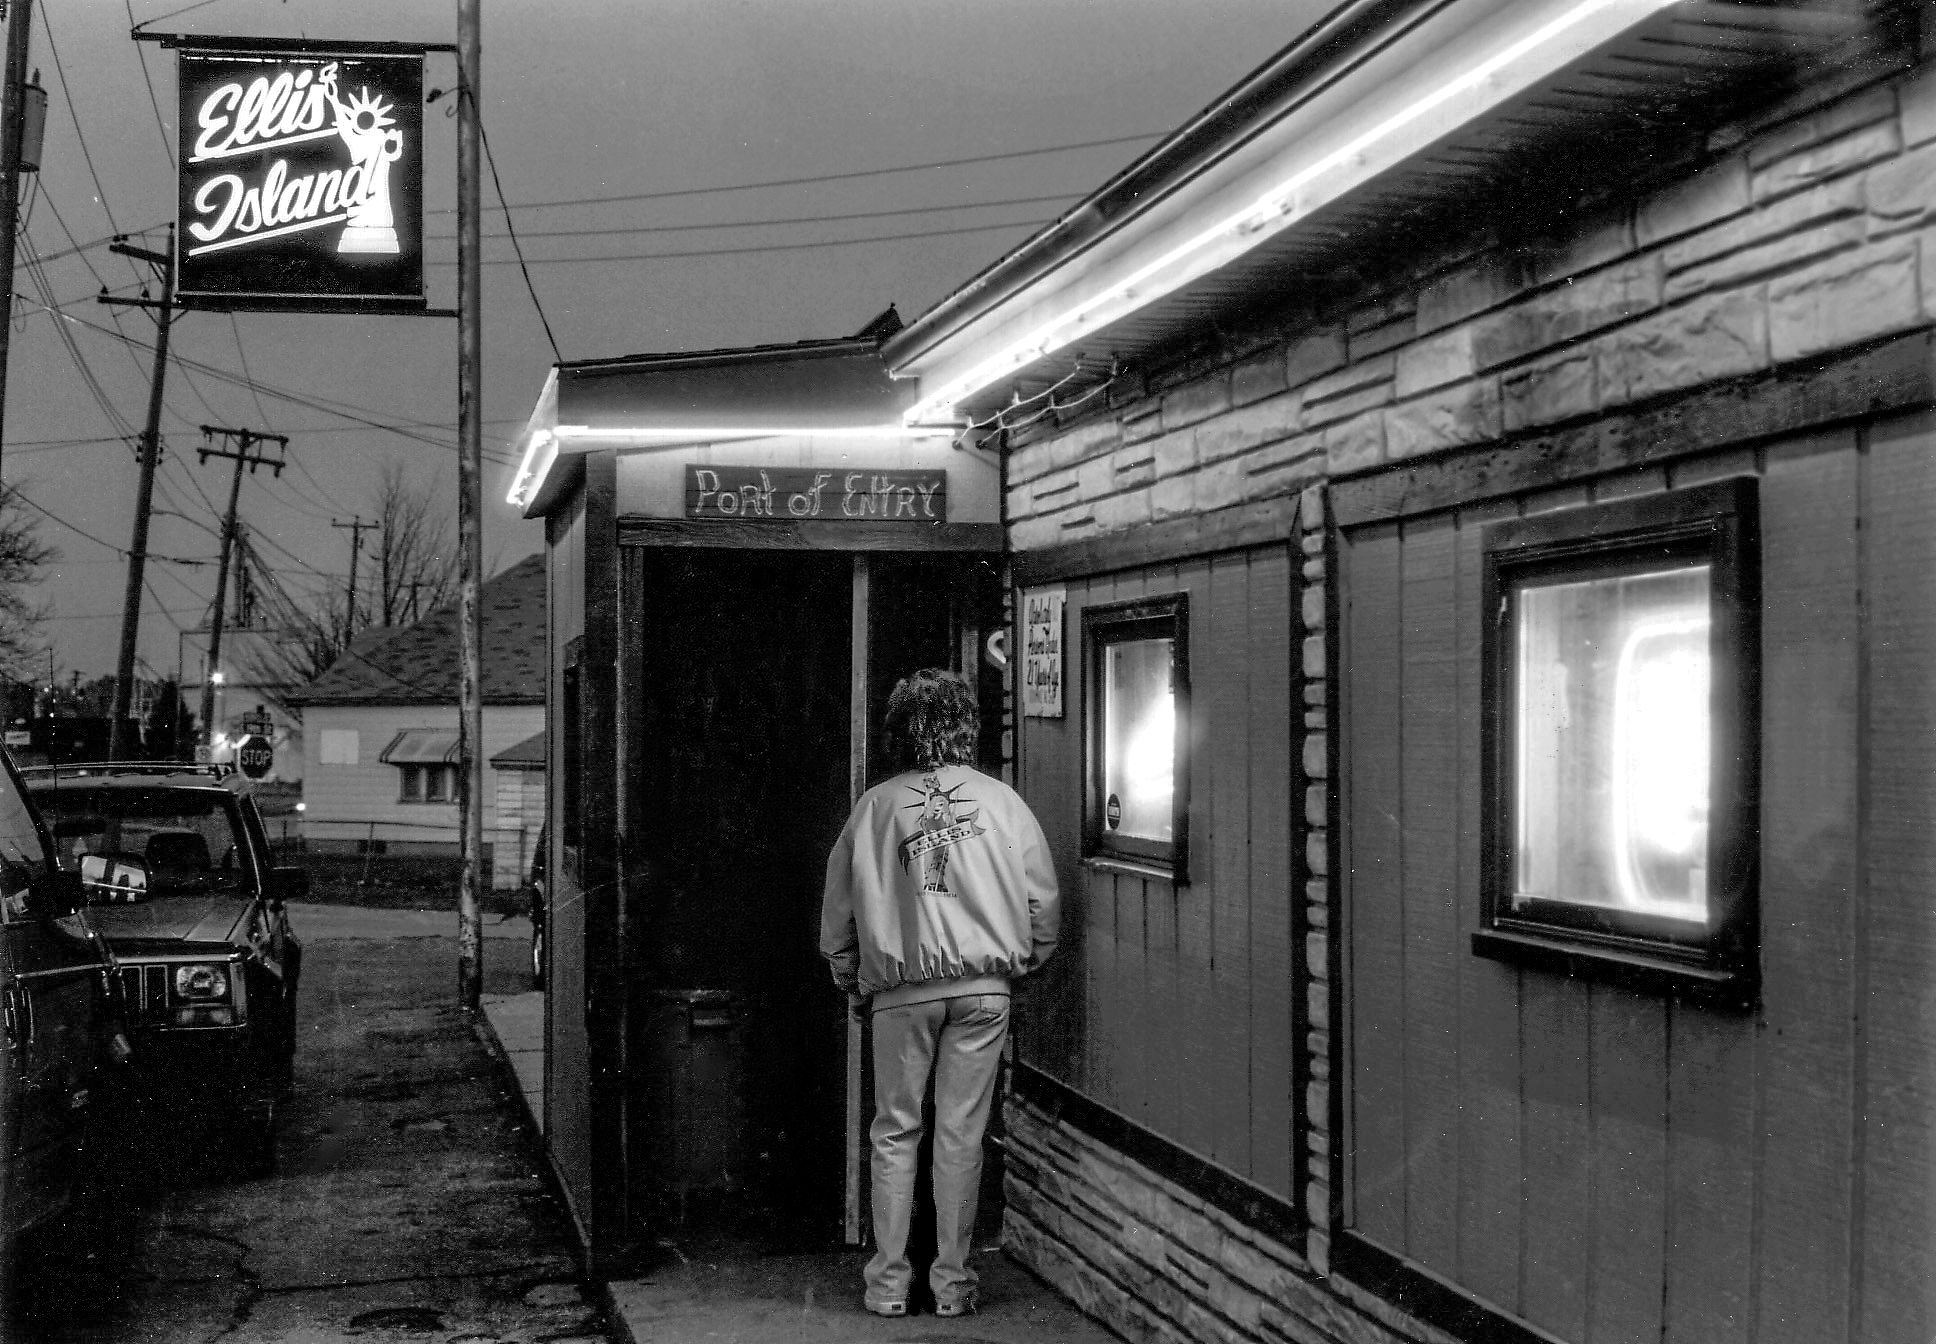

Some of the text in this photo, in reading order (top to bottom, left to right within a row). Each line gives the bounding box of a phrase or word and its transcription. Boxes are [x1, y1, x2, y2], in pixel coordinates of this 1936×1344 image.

[194, 69, 326, 159] Ellis
[188, 155, 374, 241] Island
[240, 748, 272, 766] STOP
